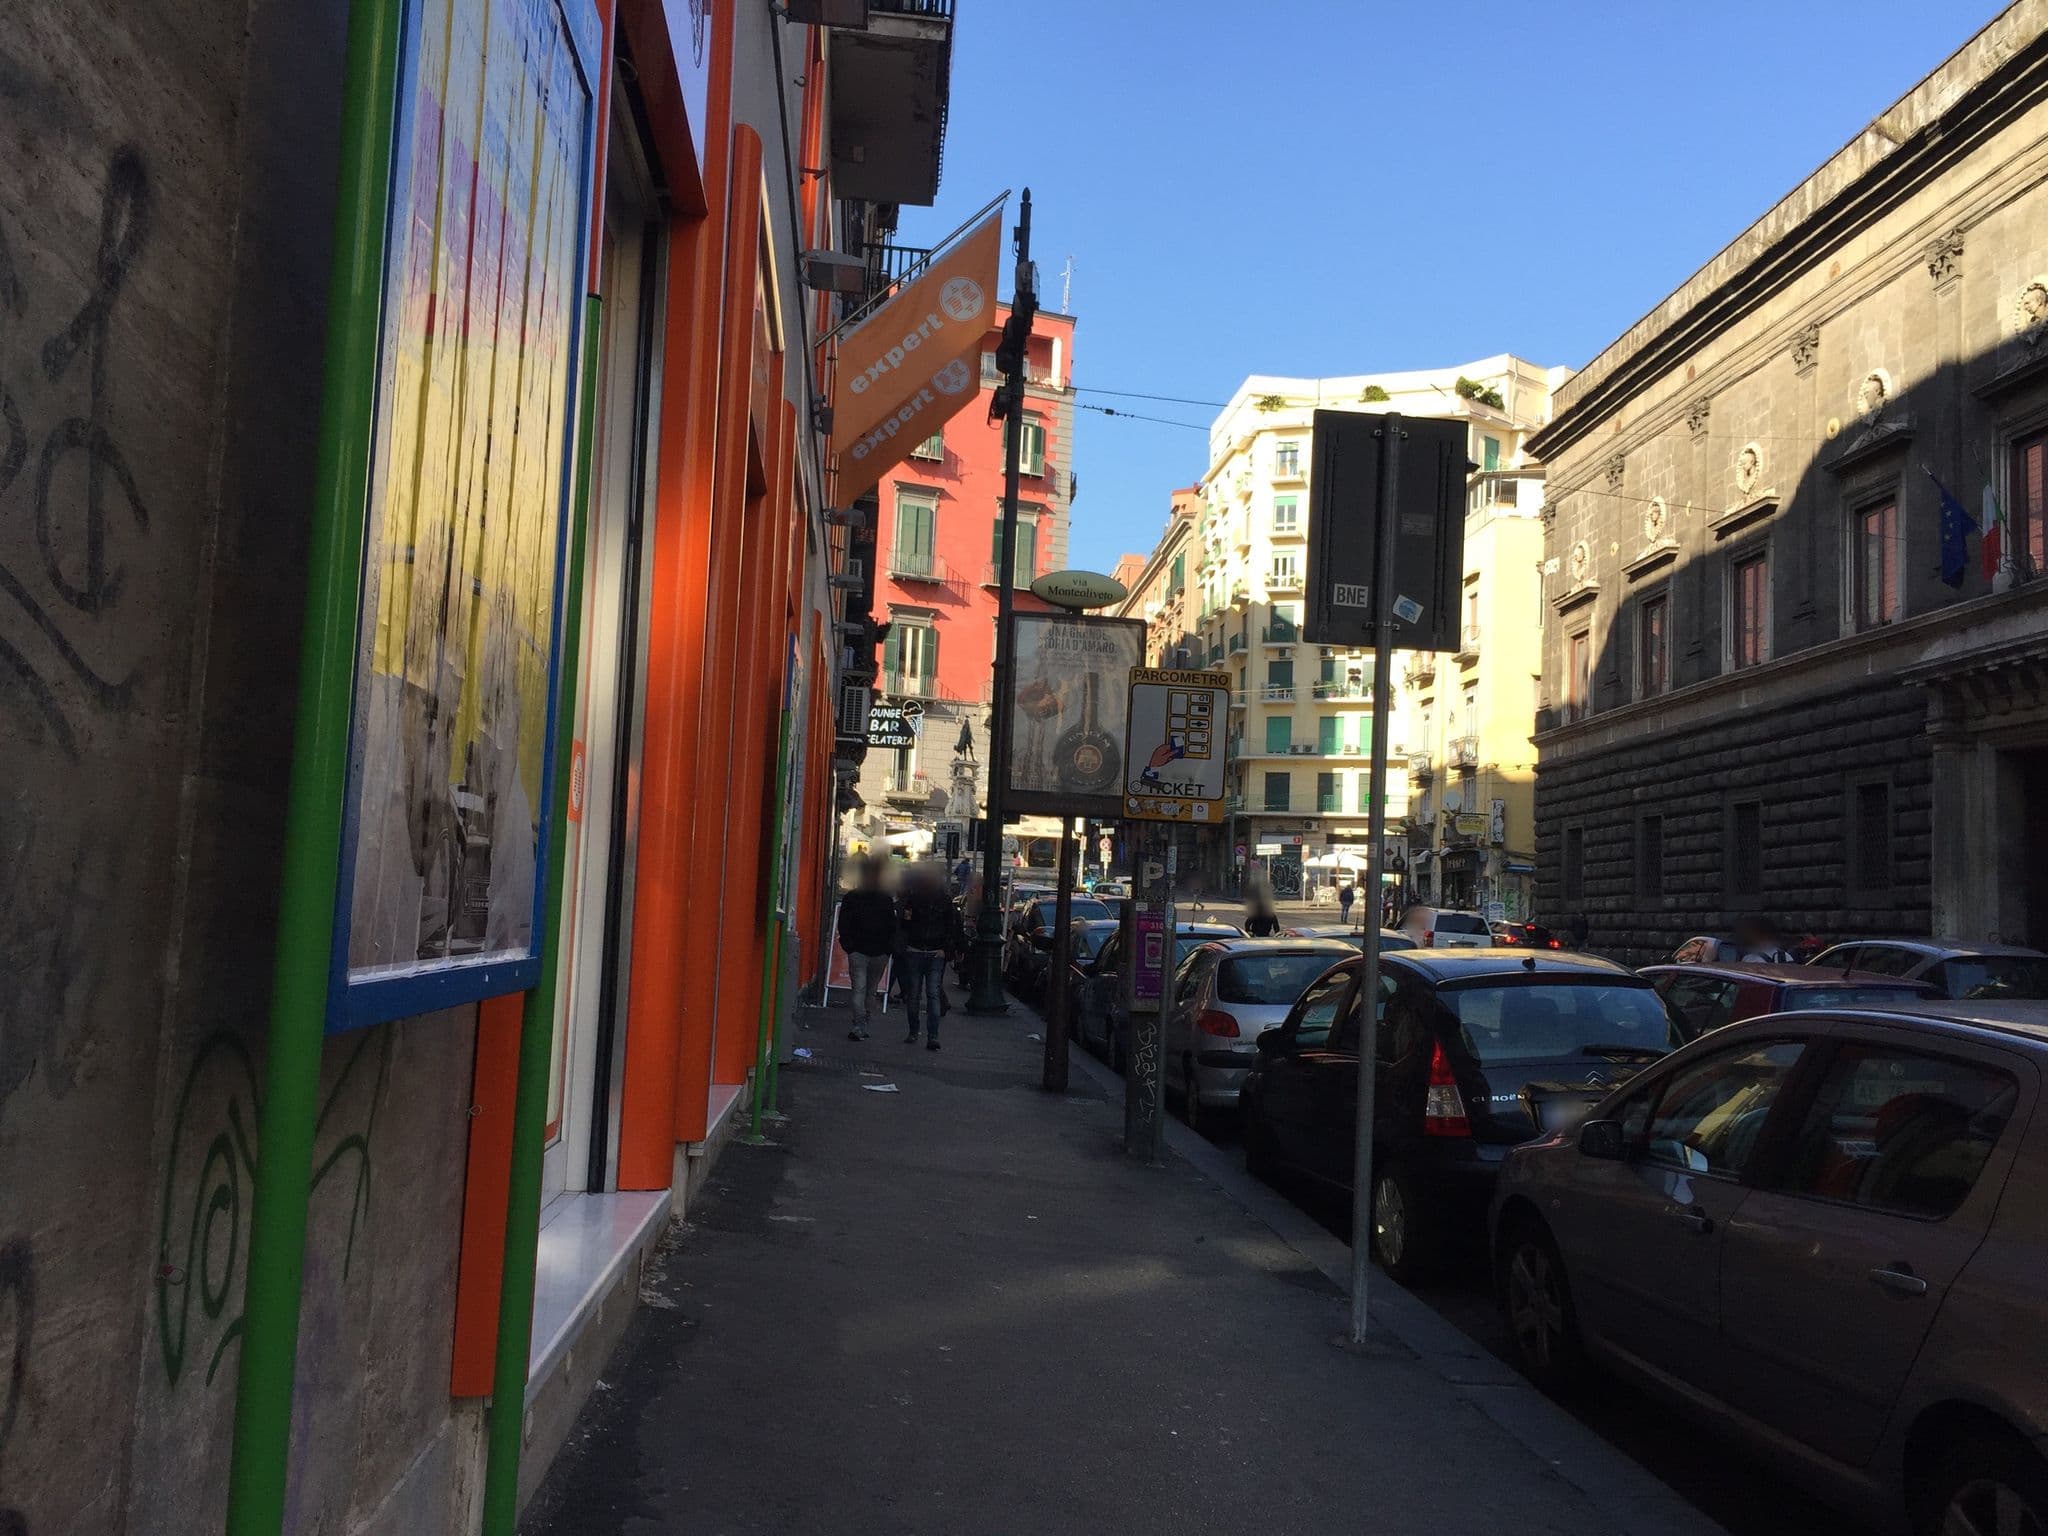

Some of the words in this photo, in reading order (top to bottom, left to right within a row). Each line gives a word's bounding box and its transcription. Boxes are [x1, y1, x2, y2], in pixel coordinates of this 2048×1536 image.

[850, 314, 944, 393] expert
[853, 389, 934, 459] expert
[1072, 578, 1088, 586] via
[1048, 585, 1114, 600] Monteoliveto
[1336, 586, 1366, 605] BNE
[1134, 670, 1229, 686] PARCOMETRO
[868, 708, 901, 719] OUNGE
[869, 719, 900, 732] BAR
[866, 734, 913, 745] ELATERIA
